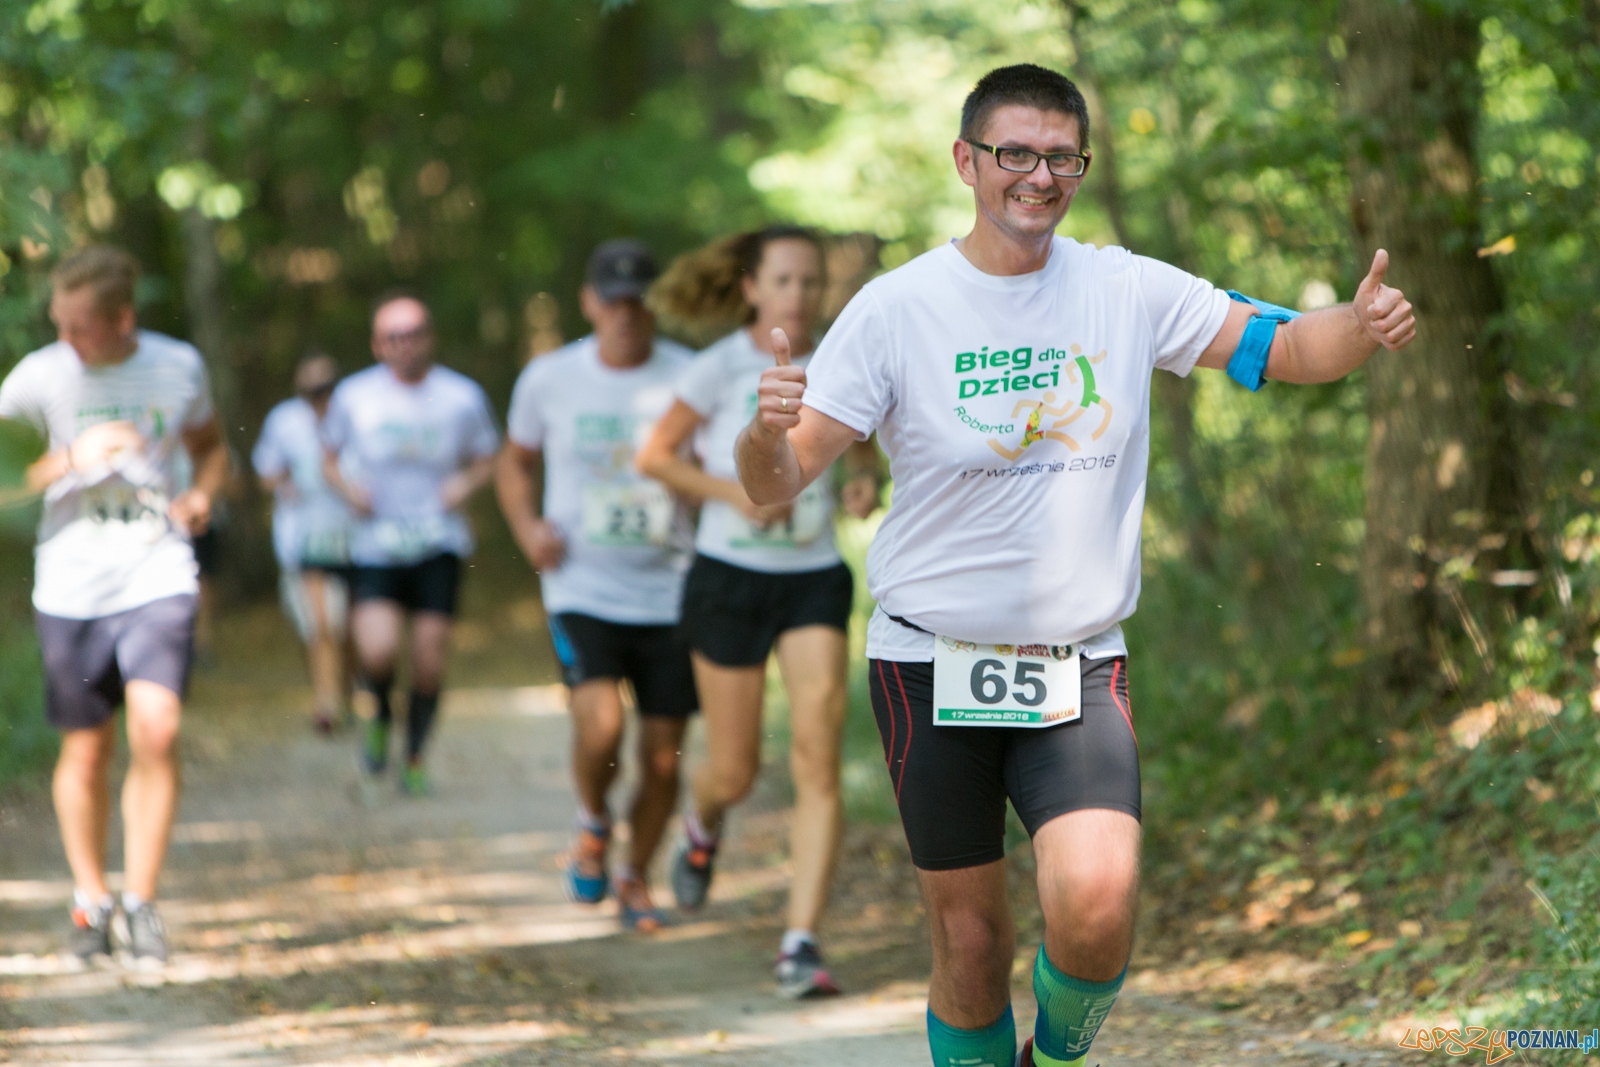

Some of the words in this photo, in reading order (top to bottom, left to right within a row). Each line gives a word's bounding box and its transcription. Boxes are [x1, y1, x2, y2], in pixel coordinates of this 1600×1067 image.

[955, 346, 1033, 373] Bieg
[1038, 348, 1066, 362] dla
[958, 364, 1060, 399] Dzieci
[953, 405, 1015, 434] Roberta
[958, 468, 984, 480] 17
[986, 461, 1065, 477] września
[1068, 454, 1117, 471] 2016
[1017, 648, 1051, 658] POLSKA
[970, 658, 1047, 706] 65
[951, 711, 964, 719] 17
[1002, 712, 1029, 721] 2016
